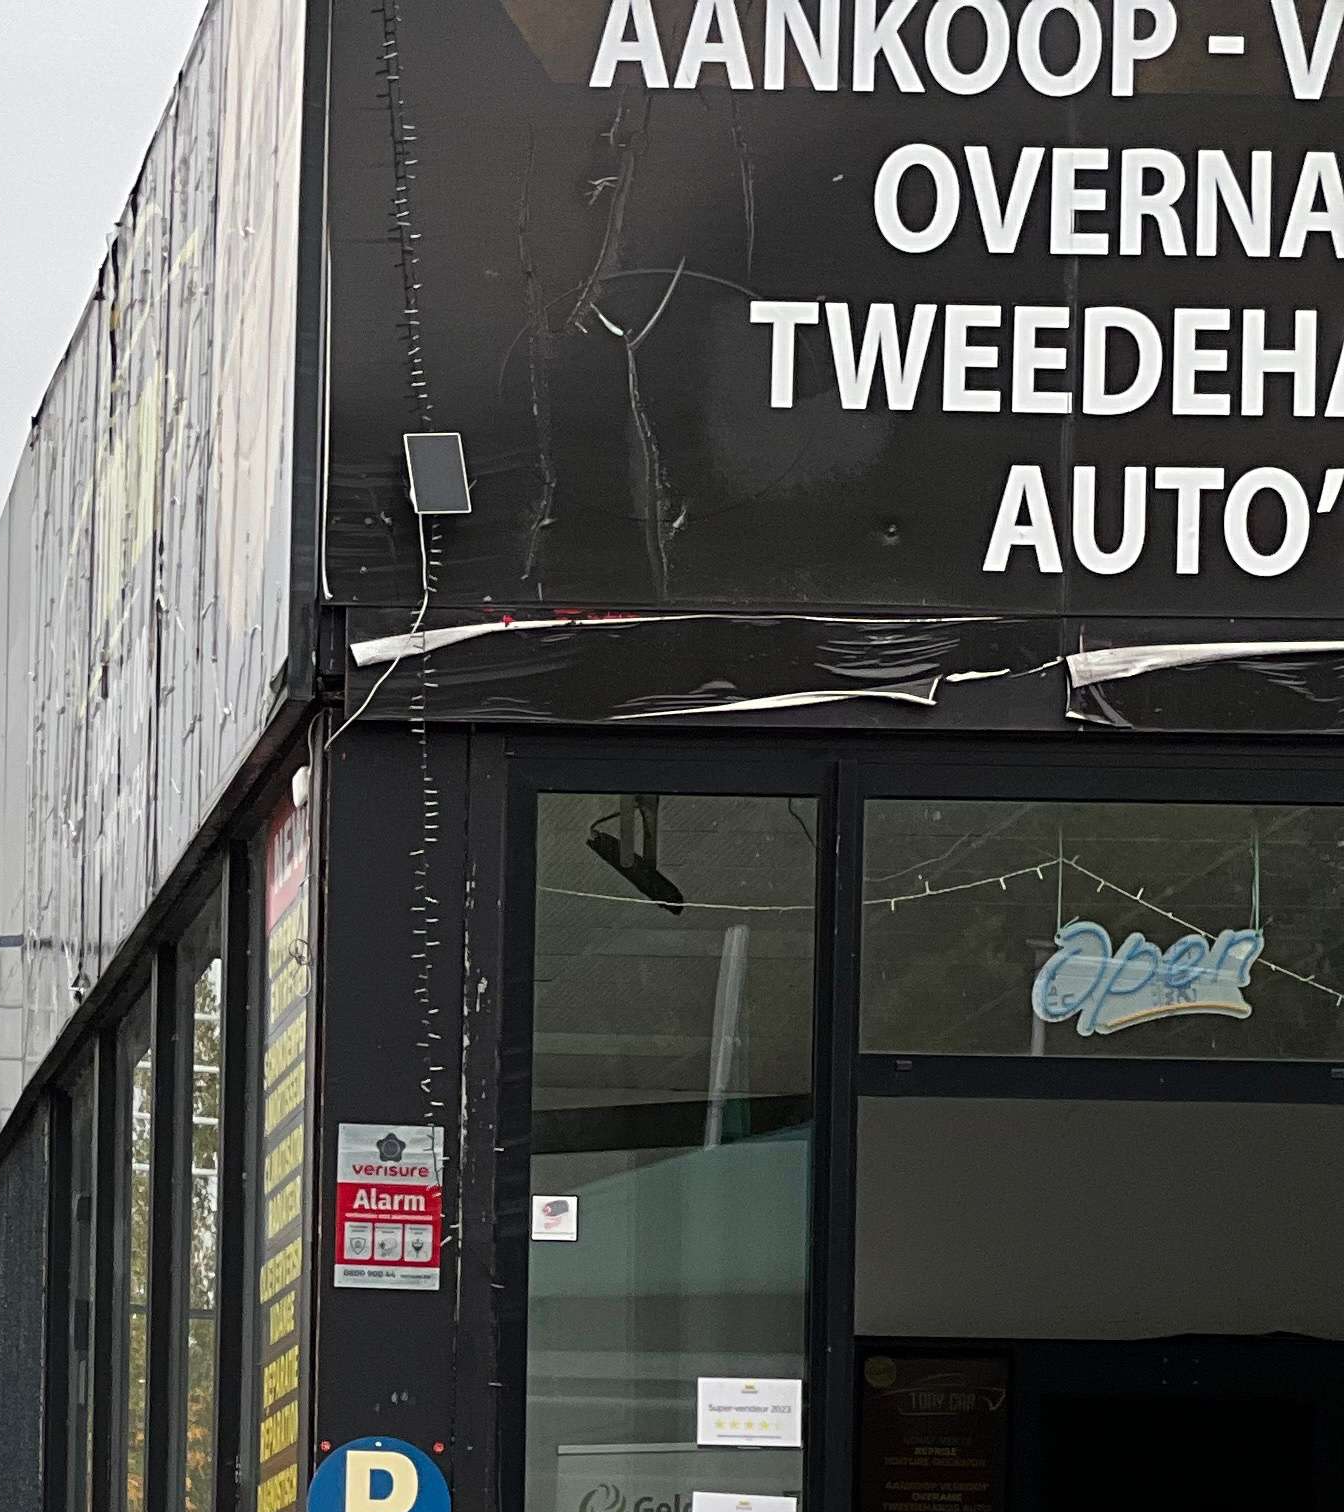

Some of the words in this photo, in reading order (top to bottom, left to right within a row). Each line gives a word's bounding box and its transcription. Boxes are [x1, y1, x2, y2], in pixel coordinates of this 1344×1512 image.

[588, 0, 1178, 97] AANKOOP
[874, 143, 1344, 259] OVERNA
[749, 300, 1344, 418] TWEEDEH
[1039, 924, 1262, 1034] Open
[352, 1163, 430, 1179] verisure
[353, 1187, 426, 1212] Alarm
